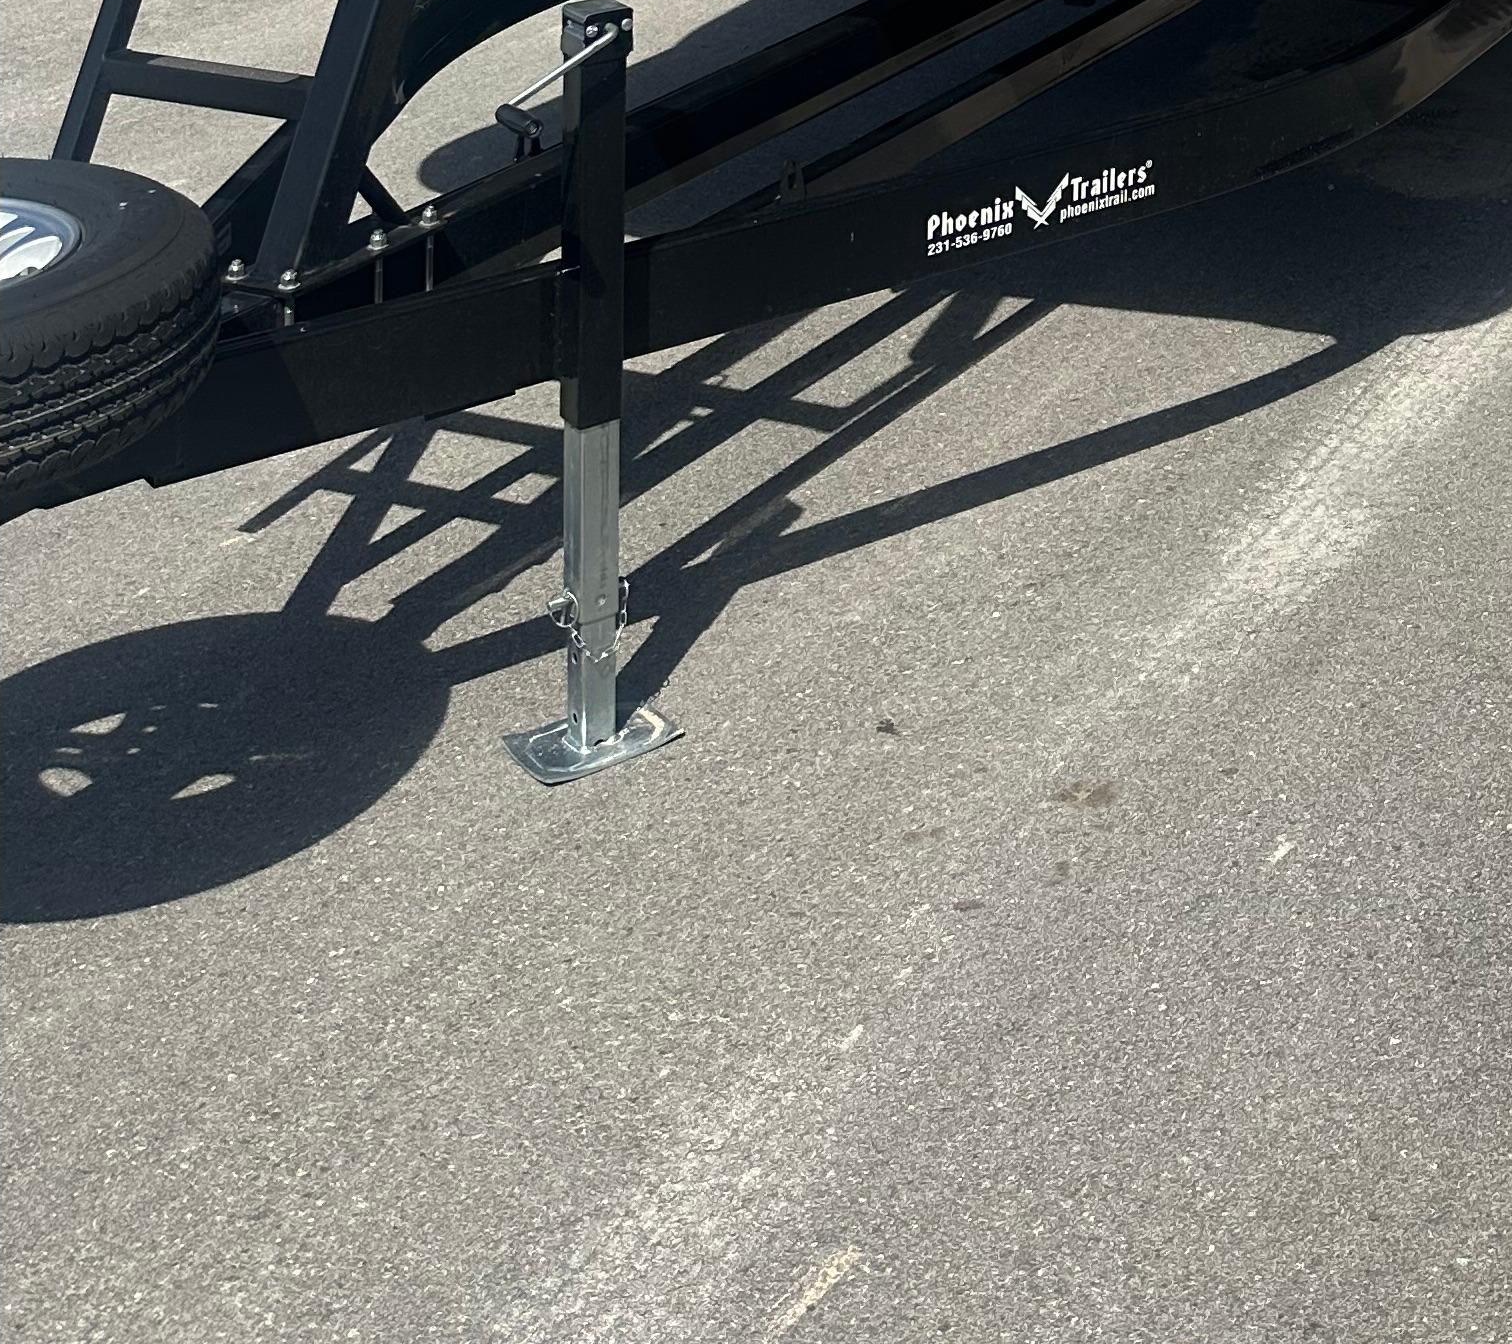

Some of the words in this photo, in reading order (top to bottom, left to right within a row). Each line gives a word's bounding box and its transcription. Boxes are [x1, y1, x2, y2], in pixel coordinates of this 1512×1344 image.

[927, 197, 1014, 241] Phoenix
[927, 222, 1013, 257] 231-536-9760
[1059, 184, 1155, 224] phoenixtrail.com
